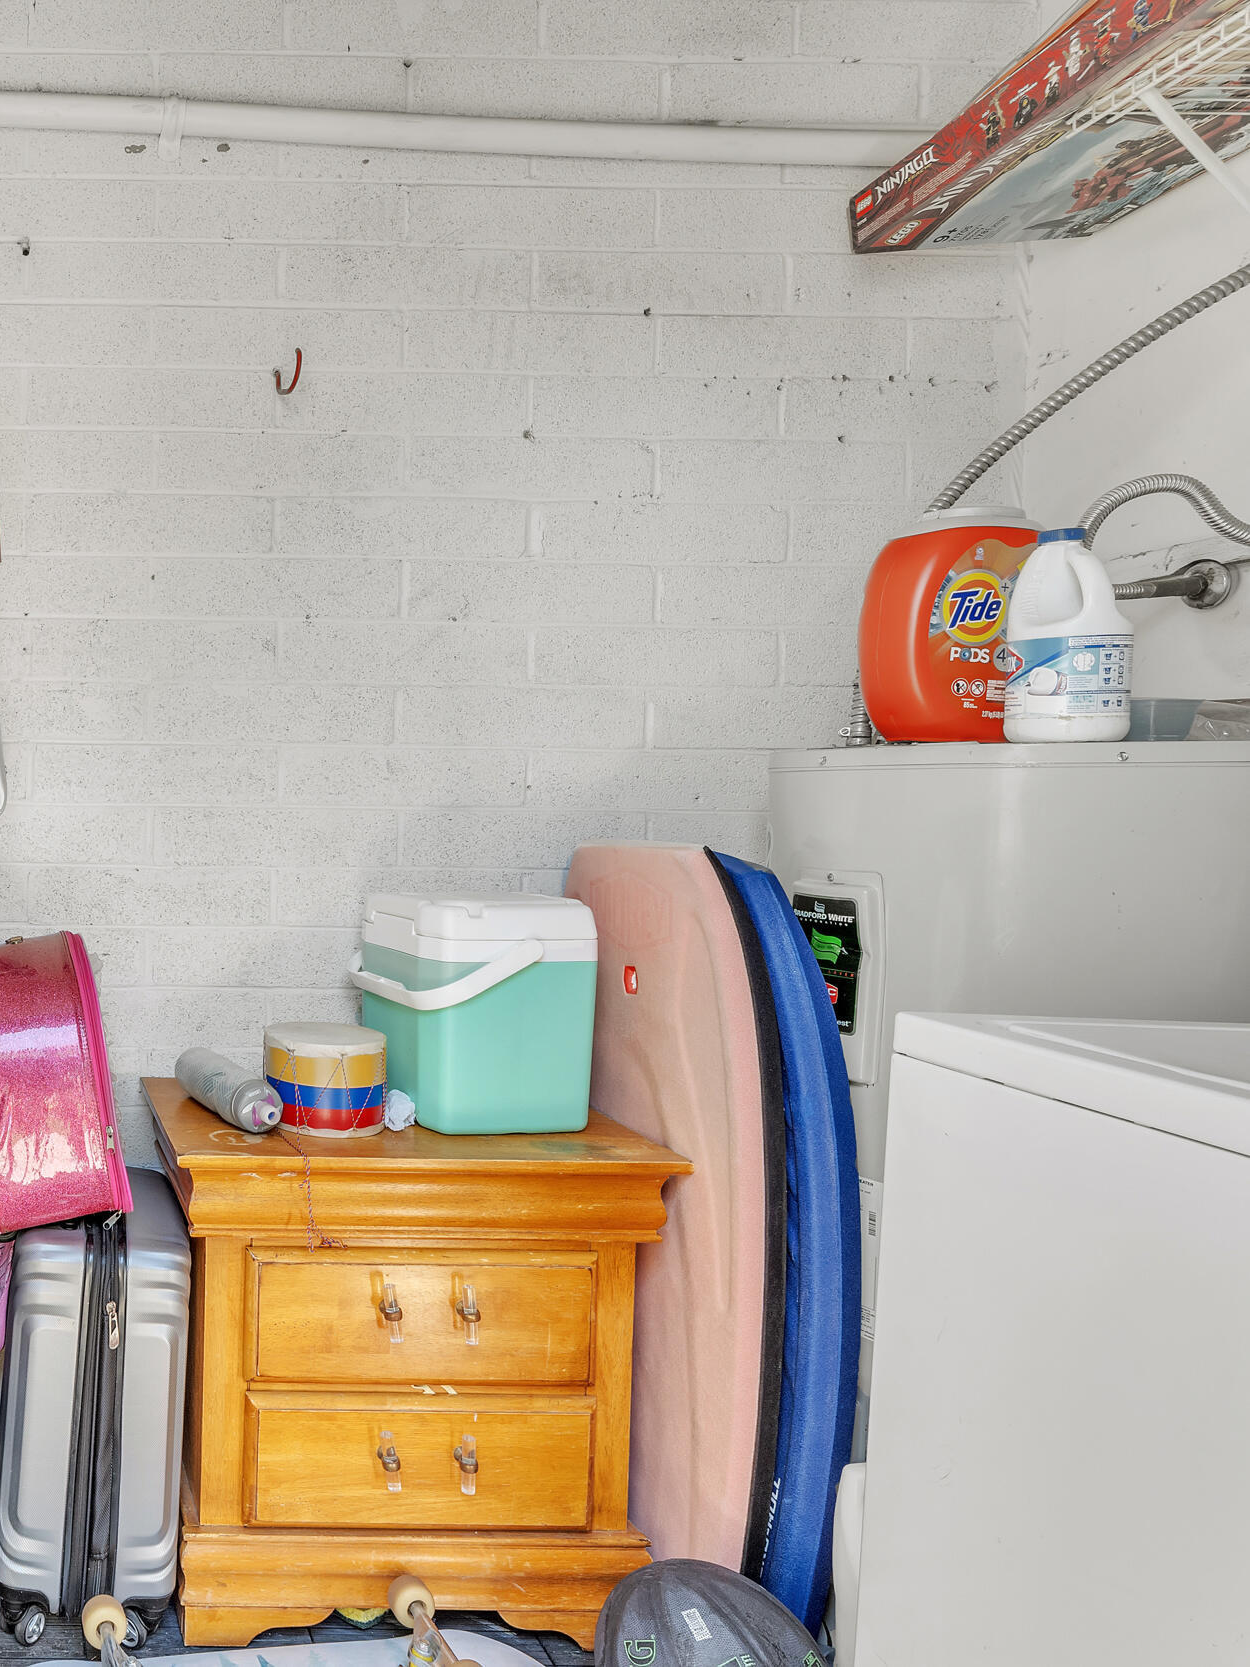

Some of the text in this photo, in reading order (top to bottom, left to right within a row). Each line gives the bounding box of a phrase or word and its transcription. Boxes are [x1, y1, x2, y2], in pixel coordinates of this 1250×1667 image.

[874, 144, 939, 205] NINJAGO
[884, 220, 921, 246] LEGO
[946, 588, 1003, 630] Tide
[950, 646, 990, 664] PODS
[996, 648, 1006, 662] 4
[828, 913, 854, 923] WHITE
